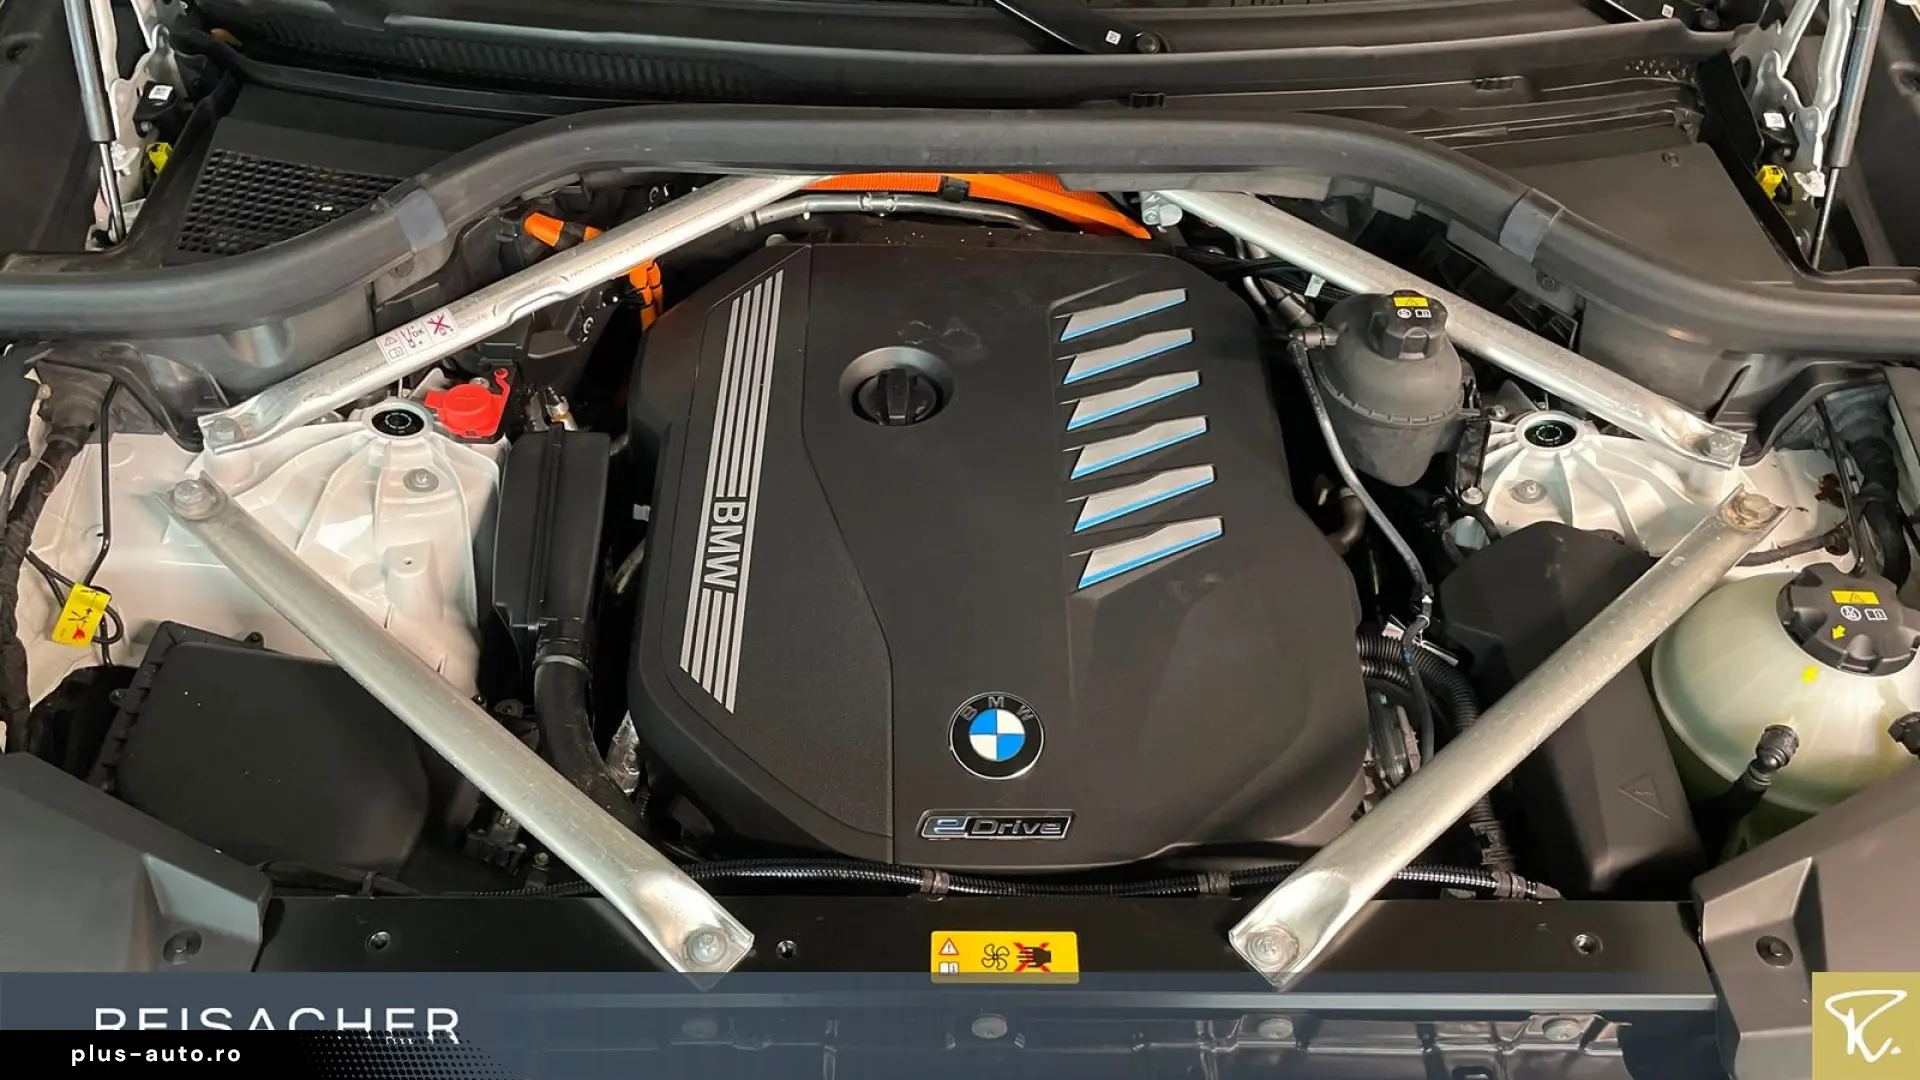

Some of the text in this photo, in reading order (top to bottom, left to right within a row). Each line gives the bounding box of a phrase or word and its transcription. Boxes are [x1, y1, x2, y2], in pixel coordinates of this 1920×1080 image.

[412, 328, 426, 338] OK
[703, 502, 746, 588] BMW
[960, 696, 1034, 721] BMW
